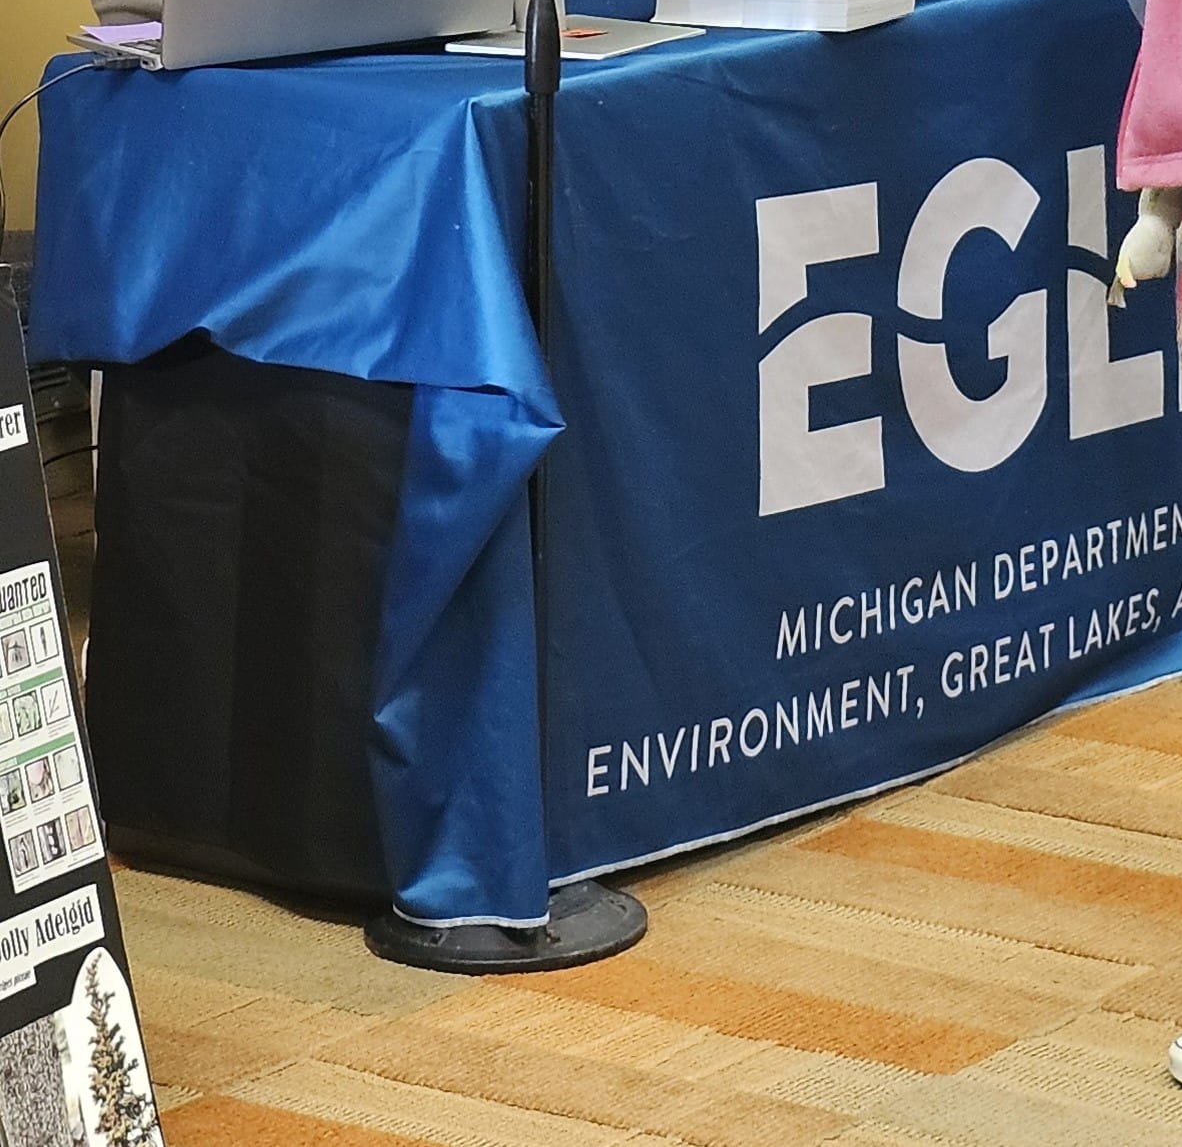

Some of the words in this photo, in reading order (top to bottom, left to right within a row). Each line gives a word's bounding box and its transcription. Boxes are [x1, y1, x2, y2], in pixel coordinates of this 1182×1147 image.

[776, 561, 976, 659] MICHIGAN
[587, 665, 924, 797] ENVIRONMENT,
[941, 624, 1055, 698] GREAT
[1068, 587, 1161, 660] LAKES,
[35, 896, 94, 947] Adelgid
